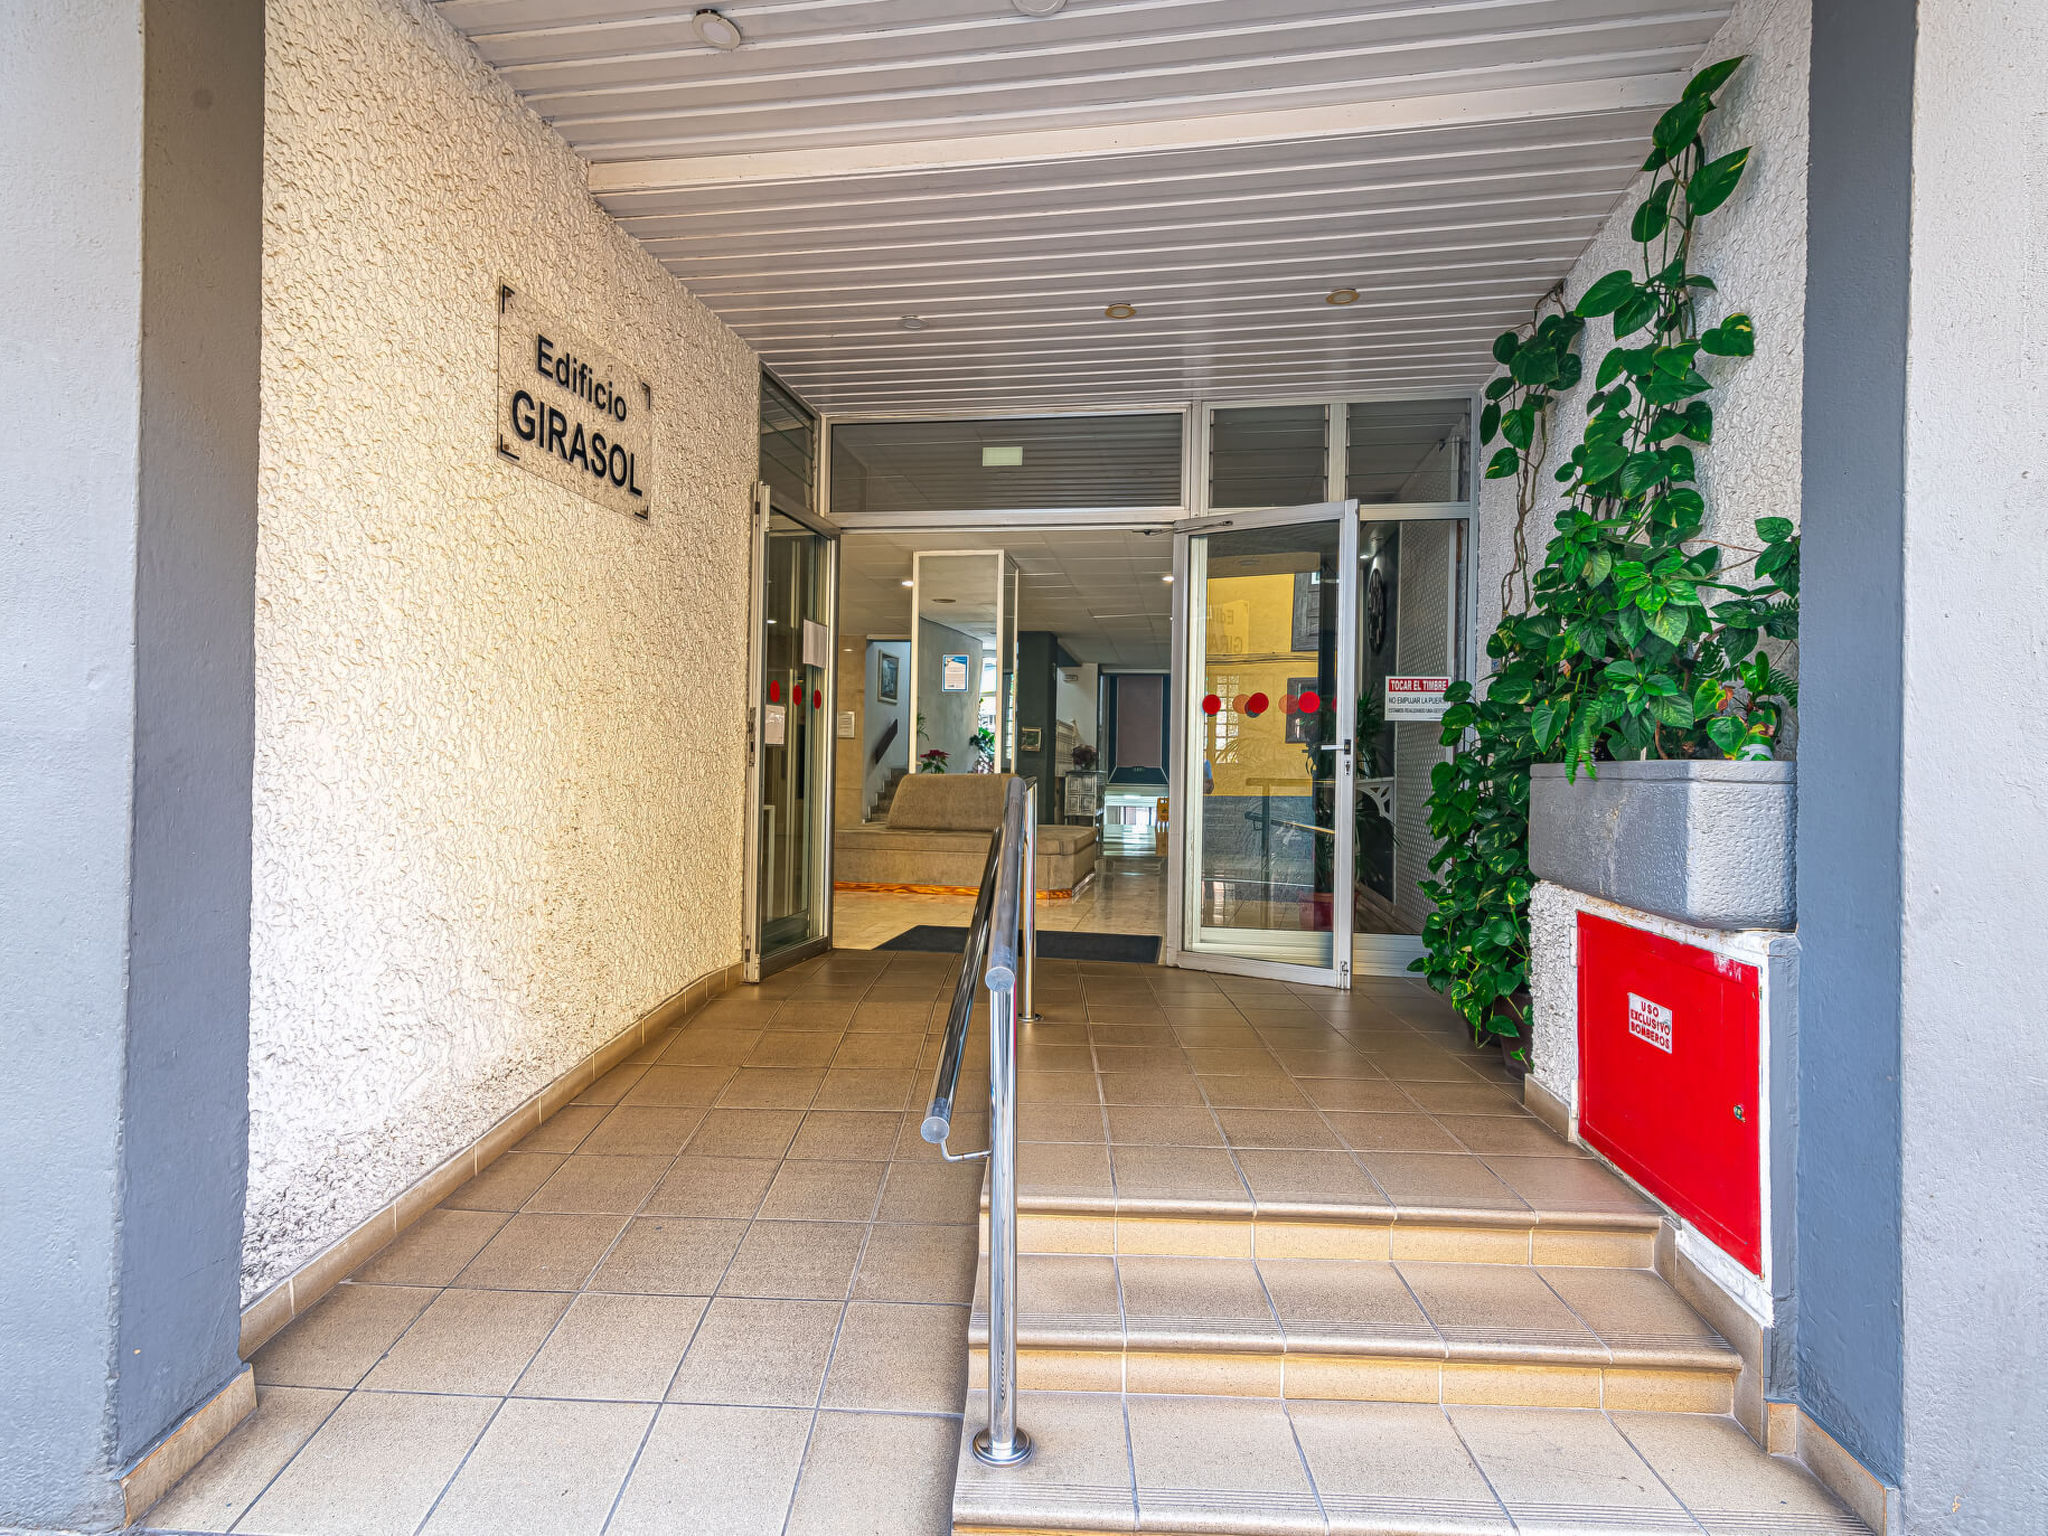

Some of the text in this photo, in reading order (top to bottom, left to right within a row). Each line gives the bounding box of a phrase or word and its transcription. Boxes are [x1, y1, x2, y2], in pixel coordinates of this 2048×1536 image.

[537, 334, 627, 422] Edificio
[512, 390, 643, 497] GIRASOL
[1390, 680, 1447, 691] TOCAR EL TIMBRE
[1389, 696, 1396, 705] NO
[1397, 696, 1421, 705] EMPUJAR
[1421, 696, 1429, 705] LA
[1630, 1009, 1671, 1036] EXCLUSIVO
[1641, 1001, 1659, 1018] USO
[1630, 1021, 1670, 1049] BOMBEROS
